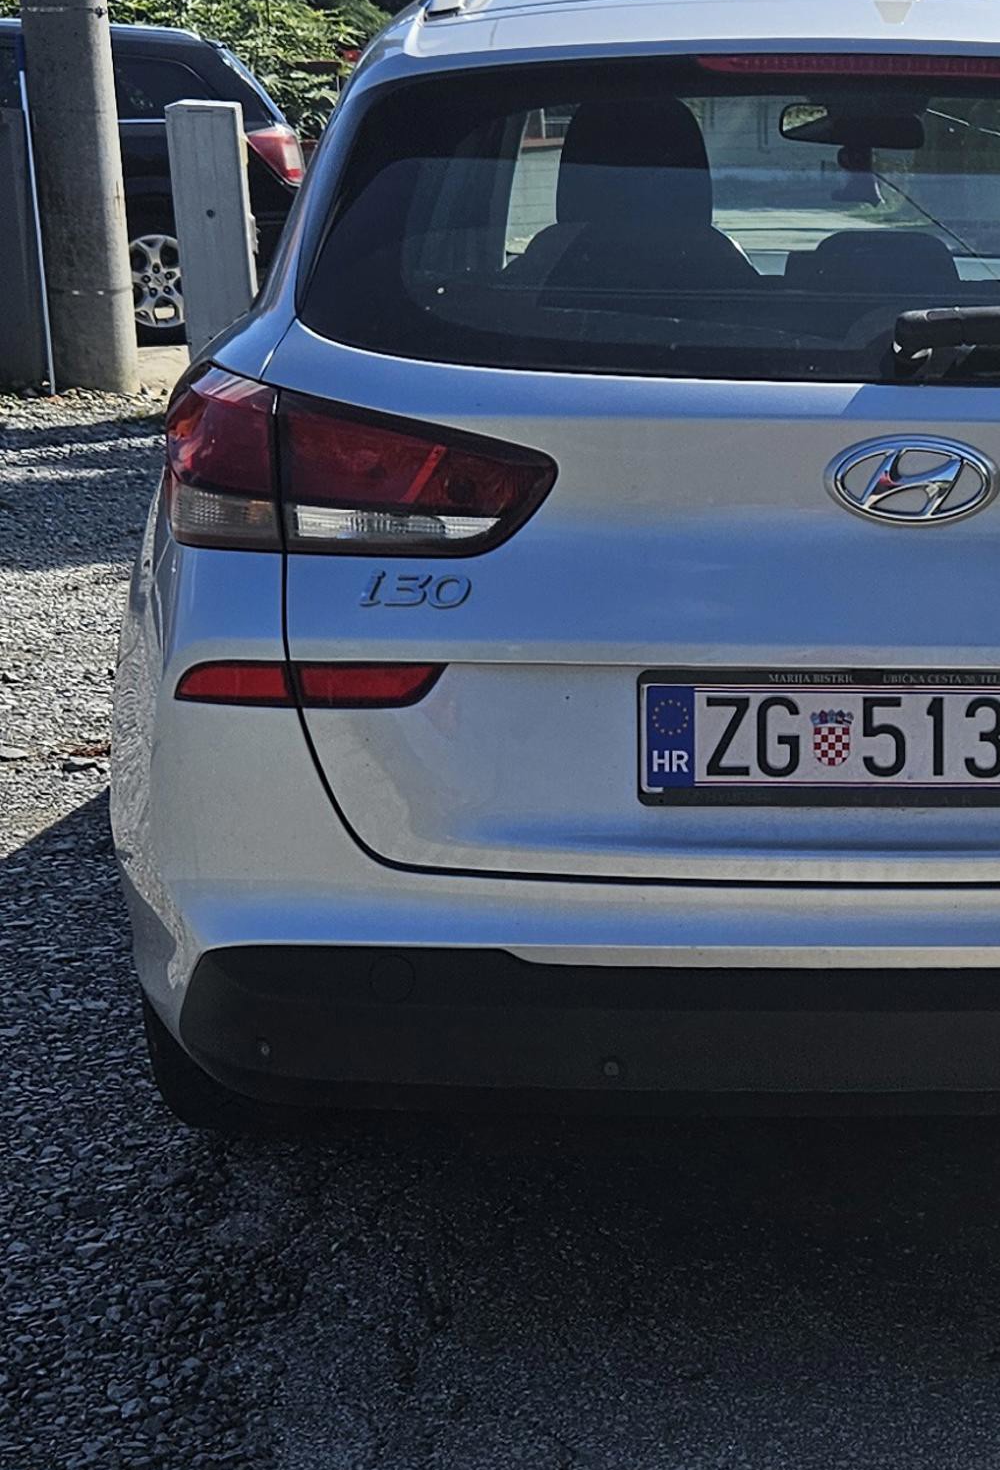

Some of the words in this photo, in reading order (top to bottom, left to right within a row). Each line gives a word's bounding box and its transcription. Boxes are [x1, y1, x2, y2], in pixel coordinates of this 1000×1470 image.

[768, 673, 811, 684] MARIJA
[927, 673, 962, 685] CESTA
[705, 696, 801, 778] ZG
[652, 749, 689, 773] HR
